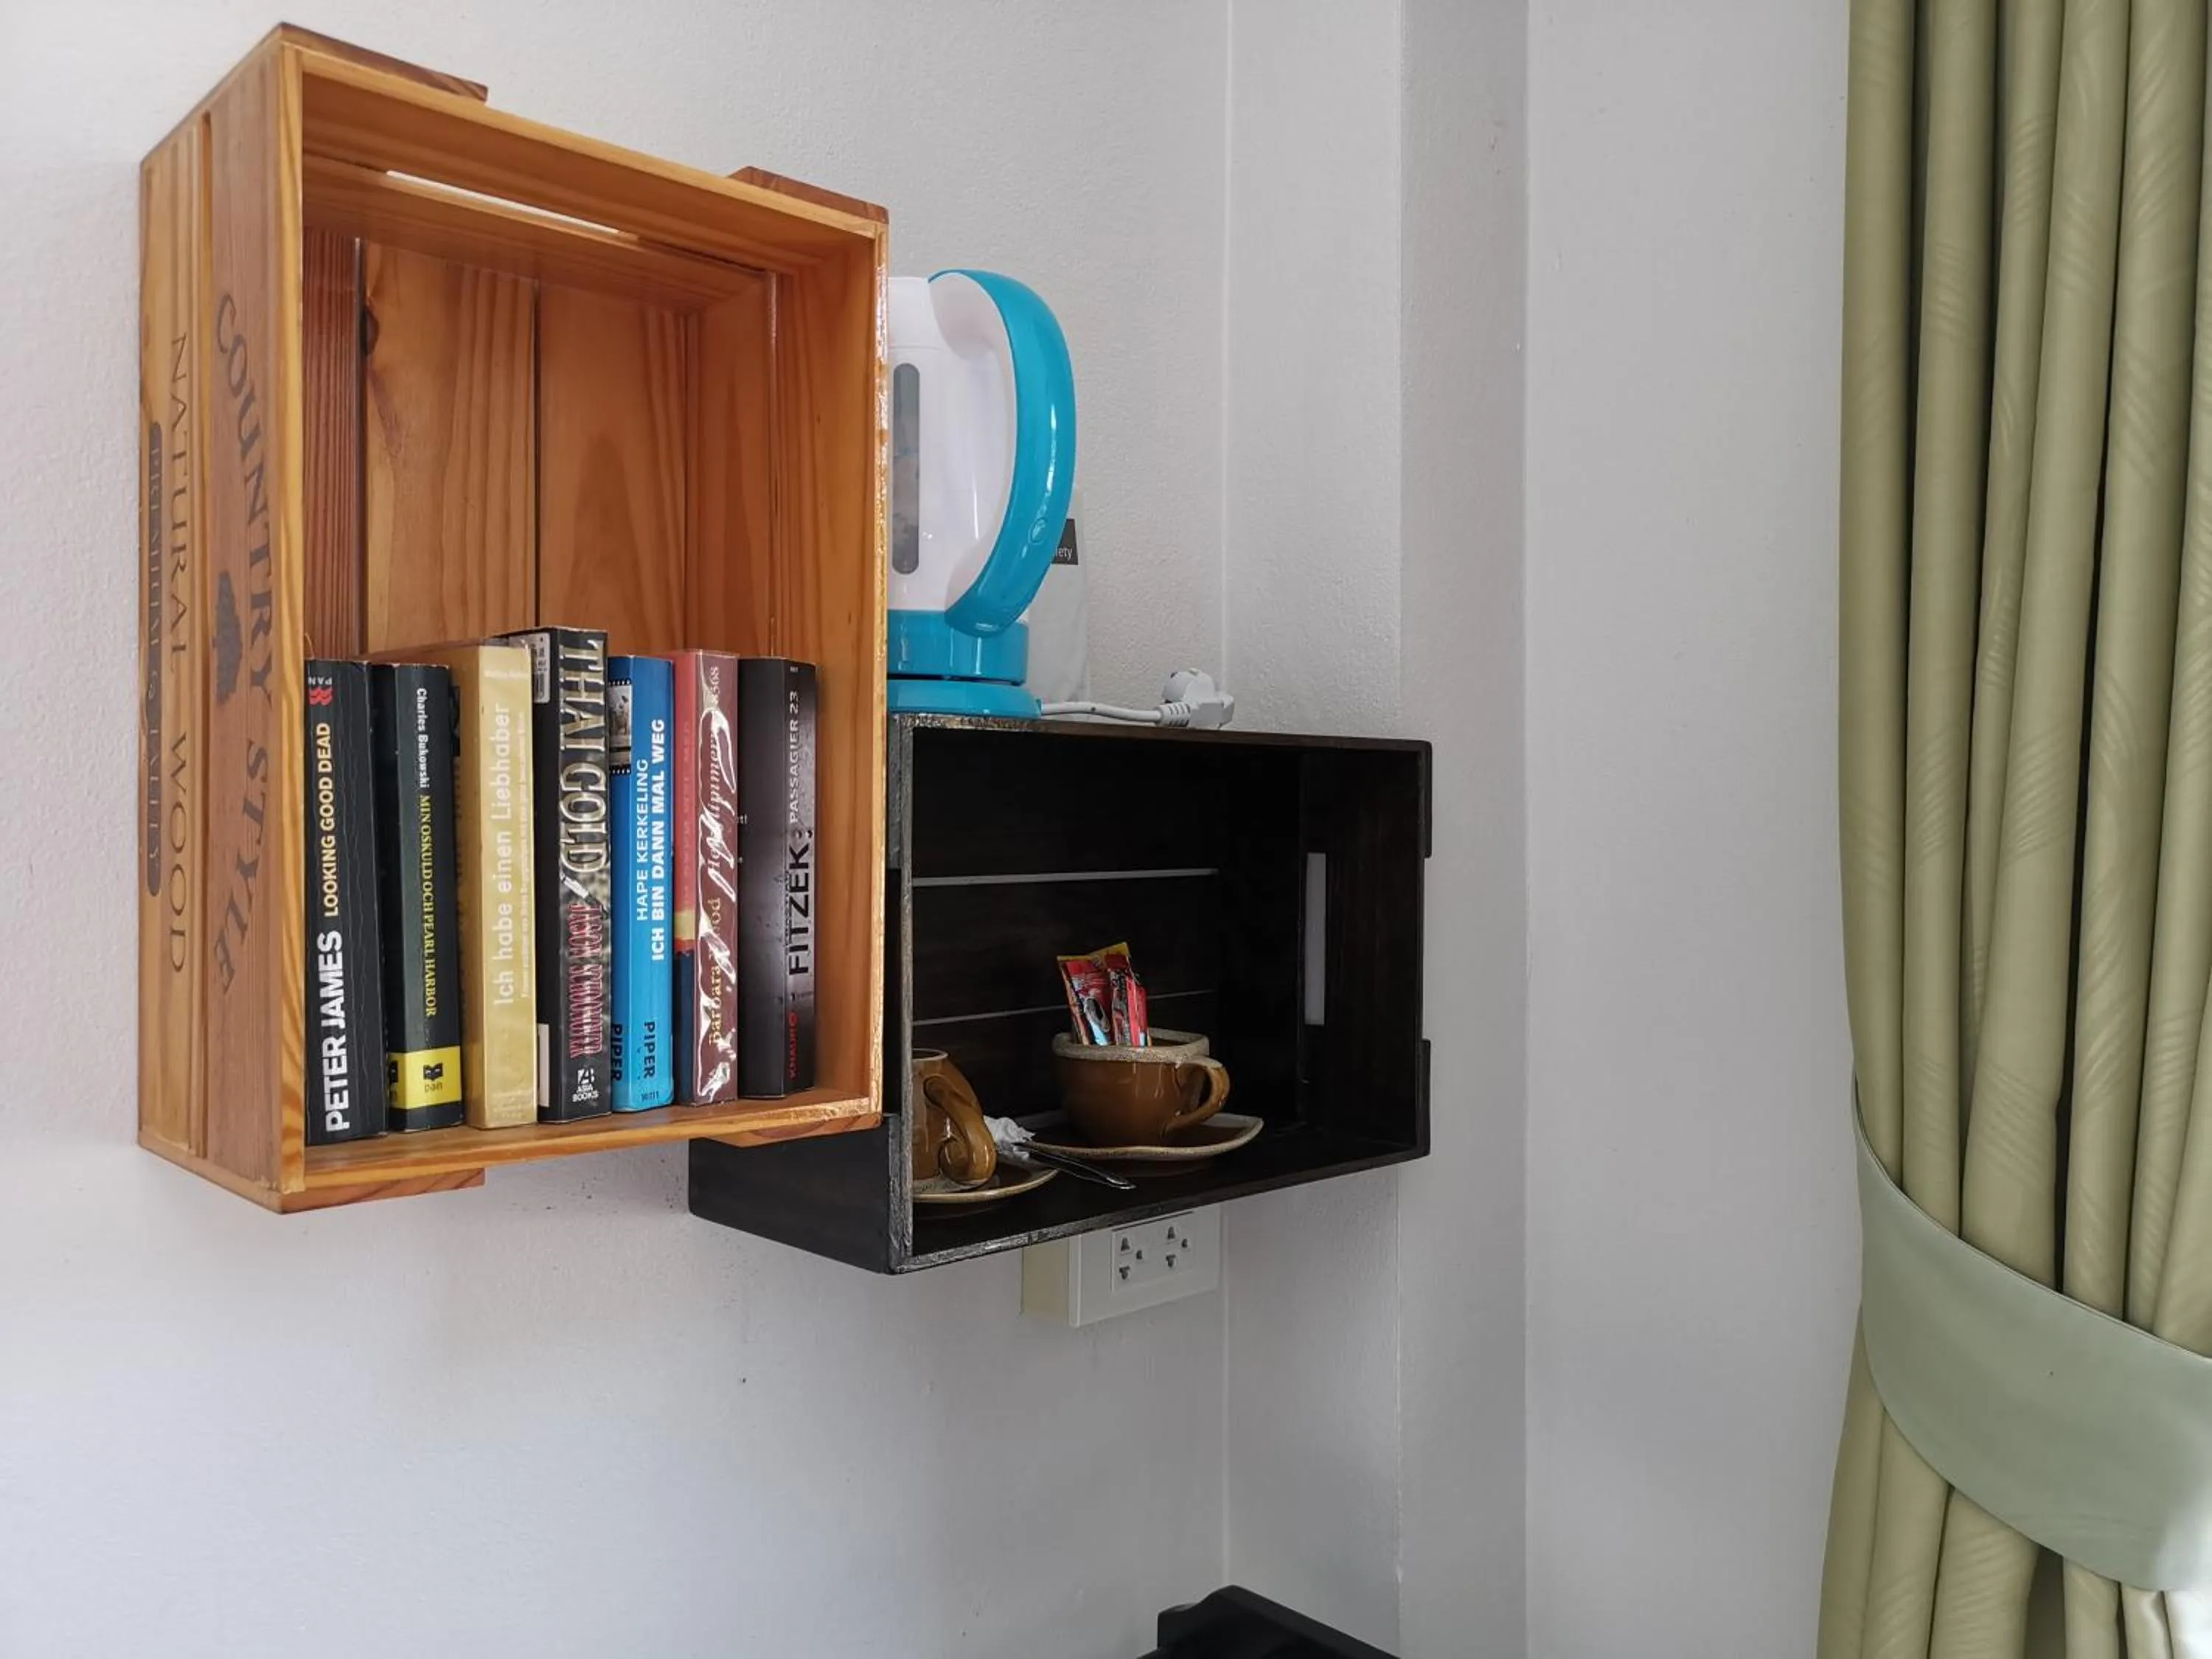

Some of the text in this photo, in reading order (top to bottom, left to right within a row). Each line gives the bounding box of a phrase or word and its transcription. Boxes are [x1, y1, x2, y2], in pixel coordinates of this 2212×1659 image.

[169, 332, 187, 973] NATURAL WOOD
[214, 292, 273, 994] COUNTRY STYLE
[417, 688, 430, 788] Charles Bukowski
[490, 703, 511, 818] Liebhaber
[559, 639, 607, 872] THAI GOLD
[492, 831, 513, 893] einen
[636, 759, 648, 920] HAPE KERKELING
[652, 719, 665, 960] ICH BIN DANN MAL WEG
[788, 691, 809, 975] FITZEK PASSAGIER 23
[316, 723, 349, 1131] PETER JAMES LOOKING GOOD DEAD
[420, 794, 437, 1017] MIN OSKULD OCH PEARL HARBOR
[491, 903, 513, 960] habe
[567, 903, 603, 959] JASON
[493, 970, 513, 1004] Ich
[709, 966, 722, 1046] Barbara
[571, 1090, 599, 1102] BOOKS
[577, 1083, 594, 1093] ASIA
[611, 1023, 622, 1081] PIPER
[644, 1021, 655, 1079] PIPER
